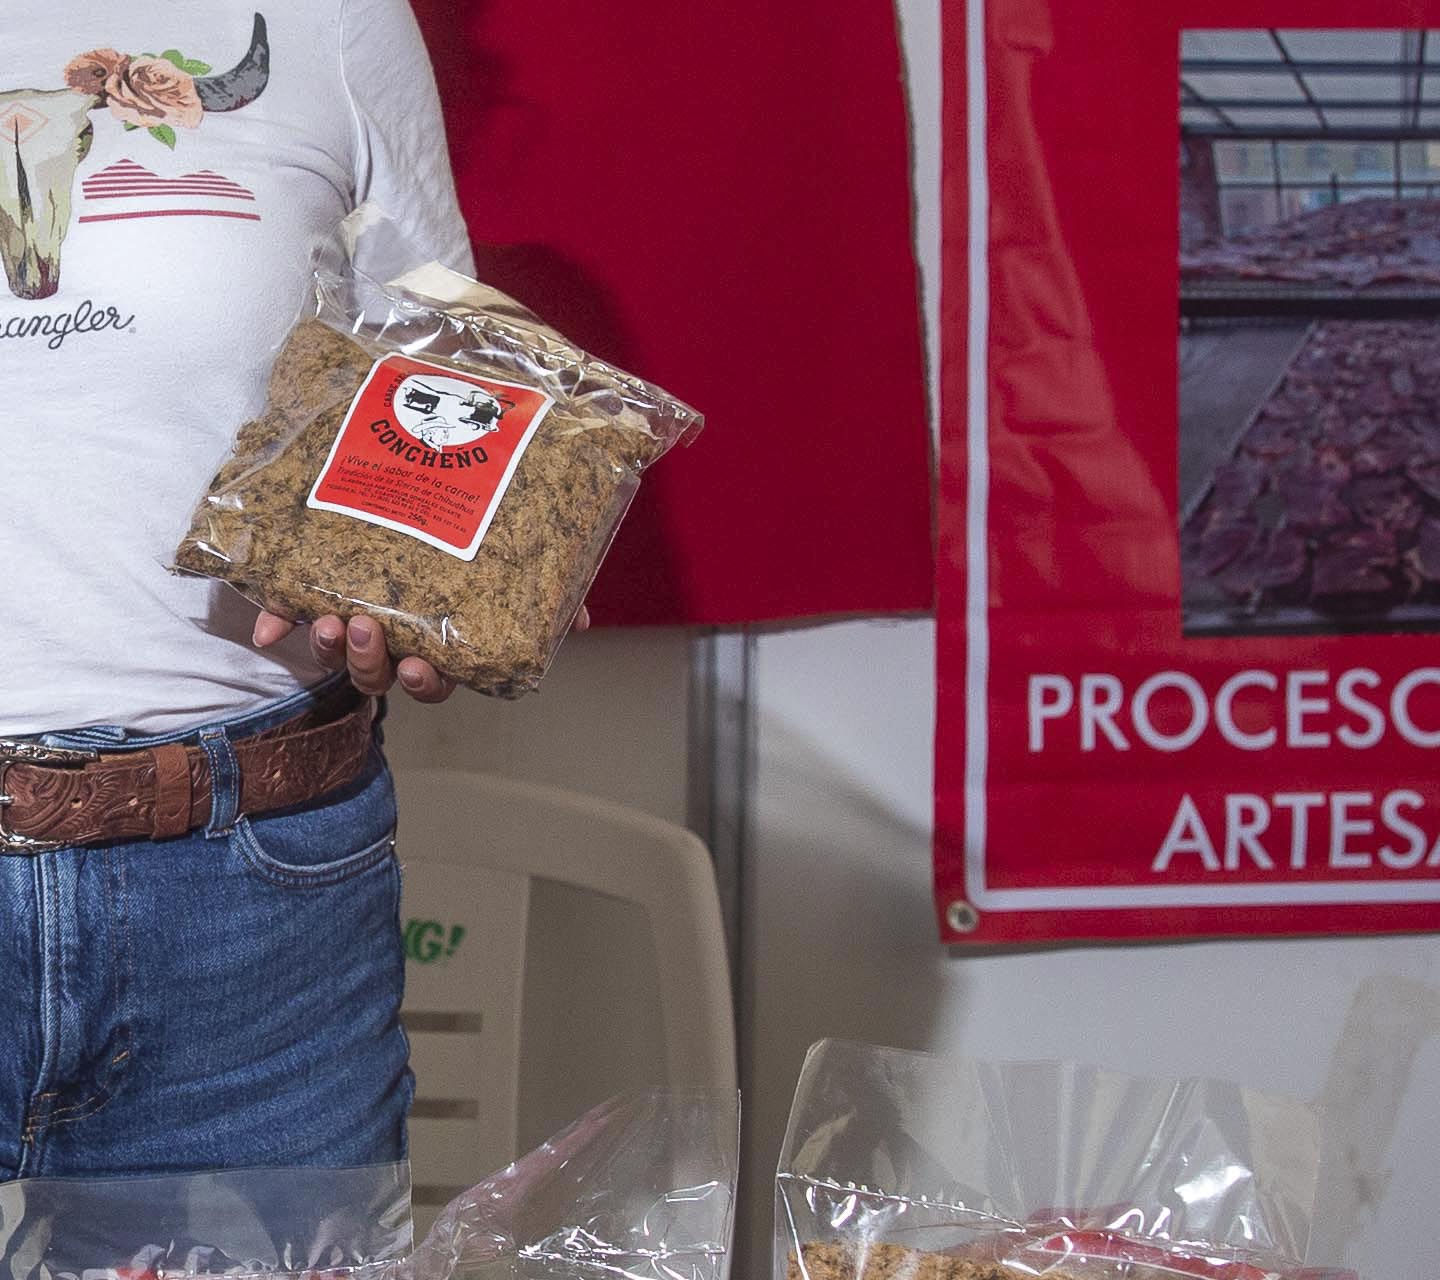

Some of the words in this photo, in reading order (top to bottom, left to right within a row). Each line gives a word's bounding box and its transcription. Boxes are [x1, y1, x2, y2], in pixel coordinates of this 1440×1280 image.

[370, 419, 489, 468] CONCHEÑO
[372, 462, 381, 471] el
[384, 464, 415, 477] sabor
[416, 472, 429, 482] de
[432, 477, 442, 488] la
[445, 485, 480, 503] carne!
